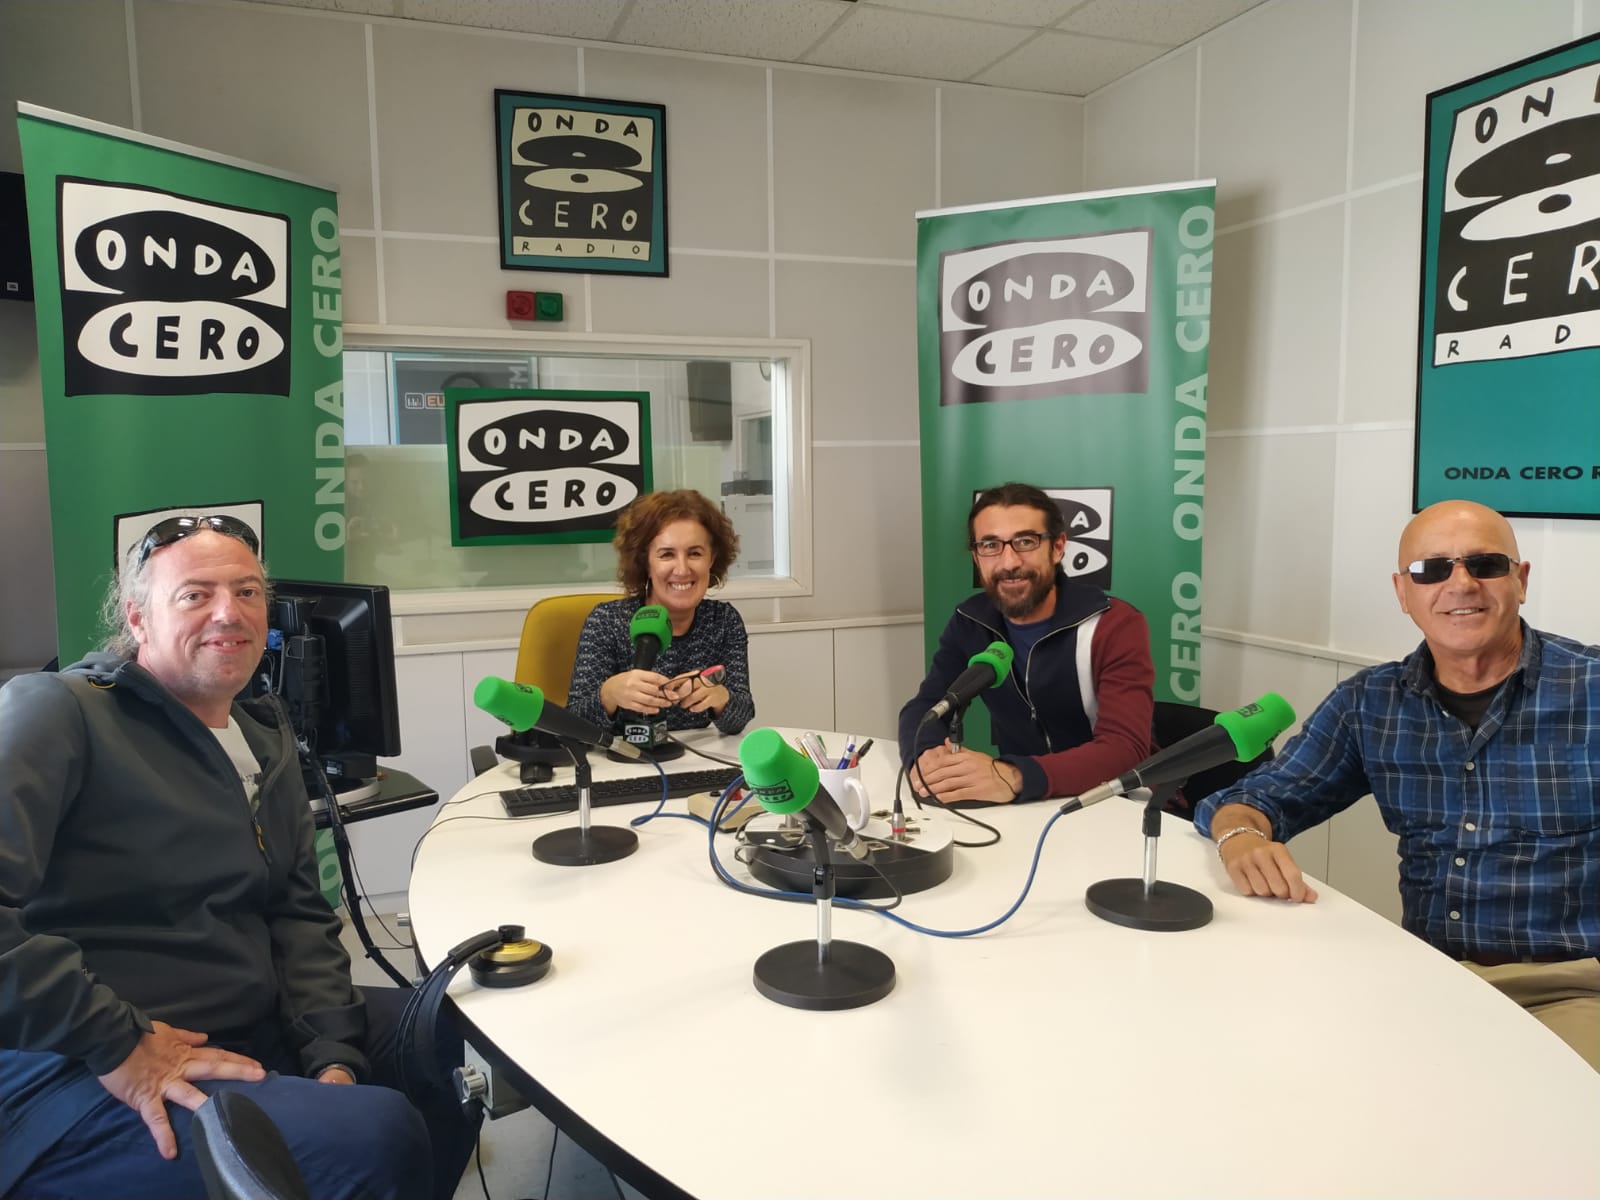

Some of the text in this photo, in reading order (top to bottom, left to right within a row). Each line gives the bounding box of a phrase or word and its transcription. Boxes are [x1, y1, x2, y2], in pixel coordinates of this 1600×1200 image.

[528, 112, 639, 137] ONDA
[1475, 74, 1600, 143] ON
[518, 200, 638, 231] CERO
[96, 229, 258, 283] ONDA
[522, 241, 640, 254] RADIO
[968, 270, 1114, 311] ONDA
[109, 312, 259, 360] CERO
[976, 333, 1115, 375] CERO
[311, 207, 346, 551] ONDA CERO
[484, 427, 615, 455] ONDA
[1169, 205, 1215, 702] CERO ONDA CERO
[1444, 467, 1511, 480] ONDA
[1520, 466, 1583, 480] CERO
[495, 480, 617, 511] CERO
